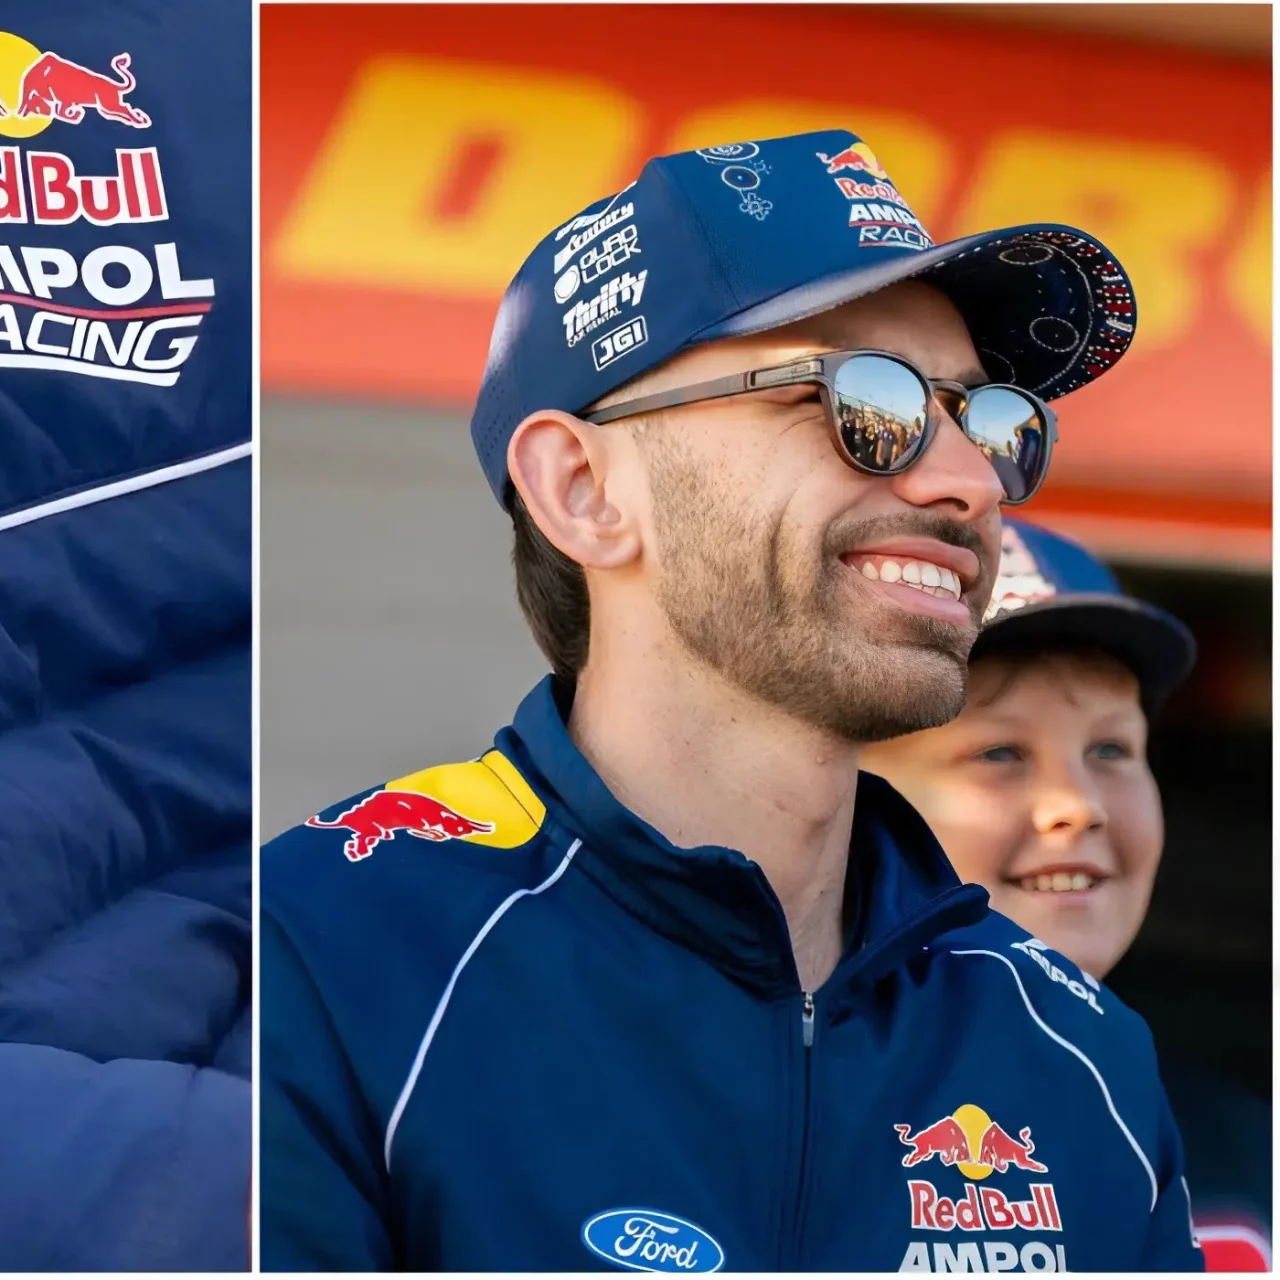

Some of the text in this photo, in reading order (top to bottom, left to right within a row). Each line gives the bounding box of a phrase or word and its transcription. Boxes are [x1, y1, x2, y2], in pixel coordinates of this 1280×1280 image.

[26, 146, 170, 226] Bull
[848, 203, 928, 236] AMP
[579, 224, 638, 270] QUAD
[581, 236, 641, 284] LOCK
[563, 269, 648, 342] Thrifty
[598, 320, 643, 366] JGI
[907, 1179, 1063, 1232] Red Bull
[614, 1217, 699, 1269] Ford
